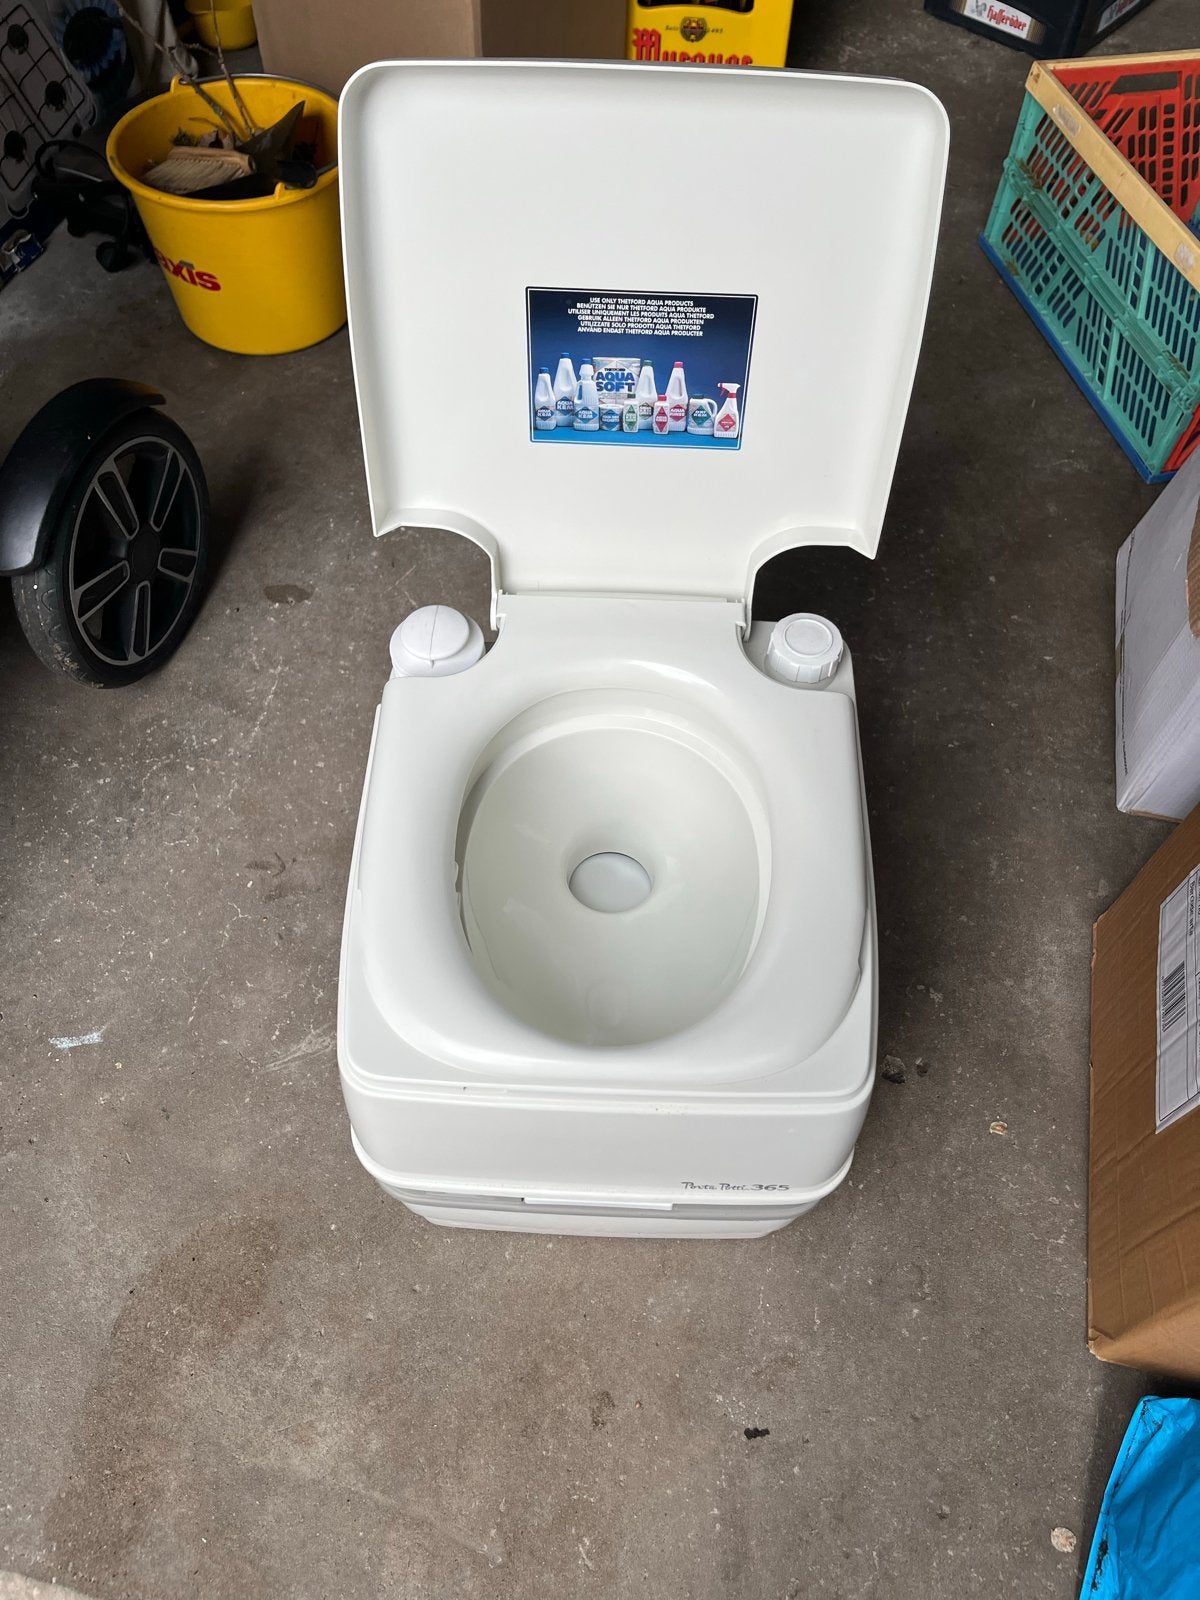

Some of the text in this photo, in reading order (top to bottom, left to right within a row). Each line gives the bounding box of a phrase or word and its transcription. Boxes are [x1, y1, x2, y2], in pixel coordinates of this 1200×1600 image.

[596, 371, 635, 382] AQUA
[596, 382, 636, 392] SOFT
[751, 1183, 790, 1191] 365
